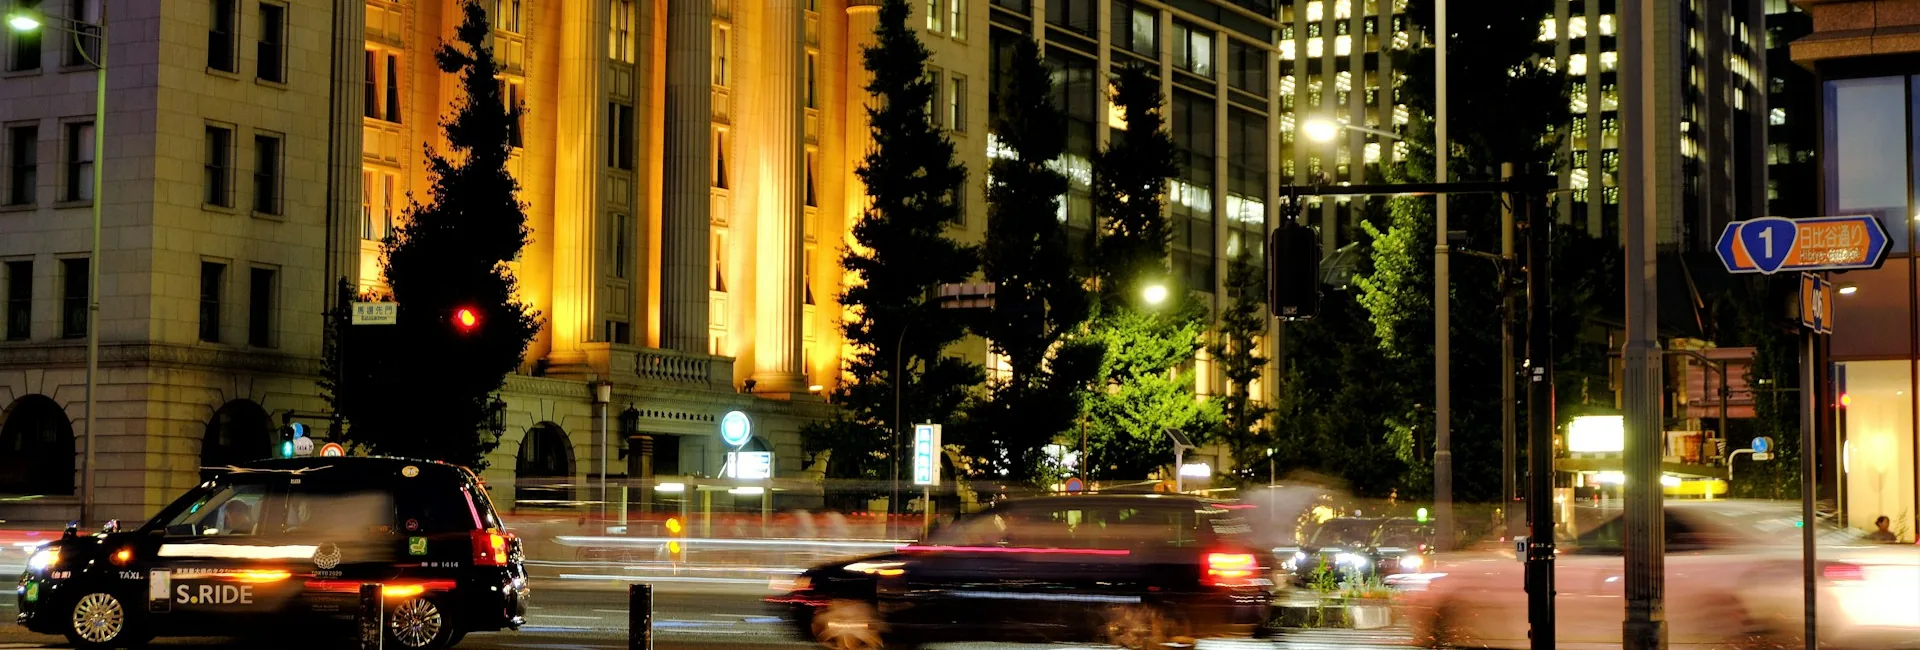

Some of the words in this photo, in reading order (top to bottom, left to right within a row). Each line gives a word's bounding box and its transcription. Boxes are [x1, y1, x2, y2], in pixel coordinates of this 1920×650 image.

[1758, 226, 1773, 259] 1
[1800, 224, 1863, 249] 日比谷通り
[176, 584, 253, 604] S.RIDE
